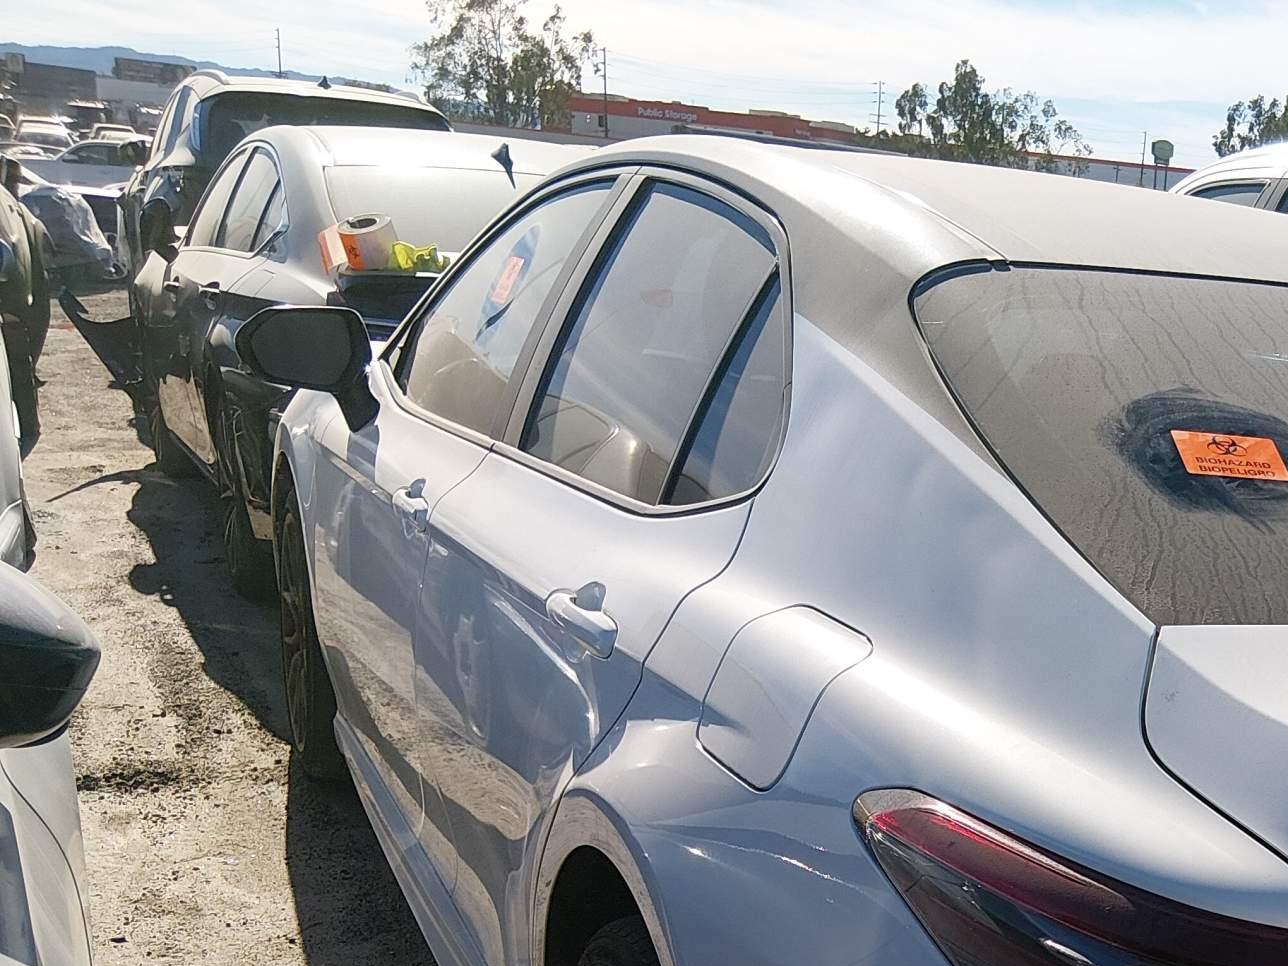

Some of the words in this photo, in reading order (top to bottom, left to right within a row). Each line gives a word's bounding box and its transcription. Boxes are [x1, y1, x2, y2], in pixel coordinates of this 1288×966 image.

[637, 106, 663, 118] Public
[665, 109, 697, 122] Storage
[1195, 456, 1271, 469] BIOHAZARD
[1198, 465, 1276, 477] BIOPELIGRO
